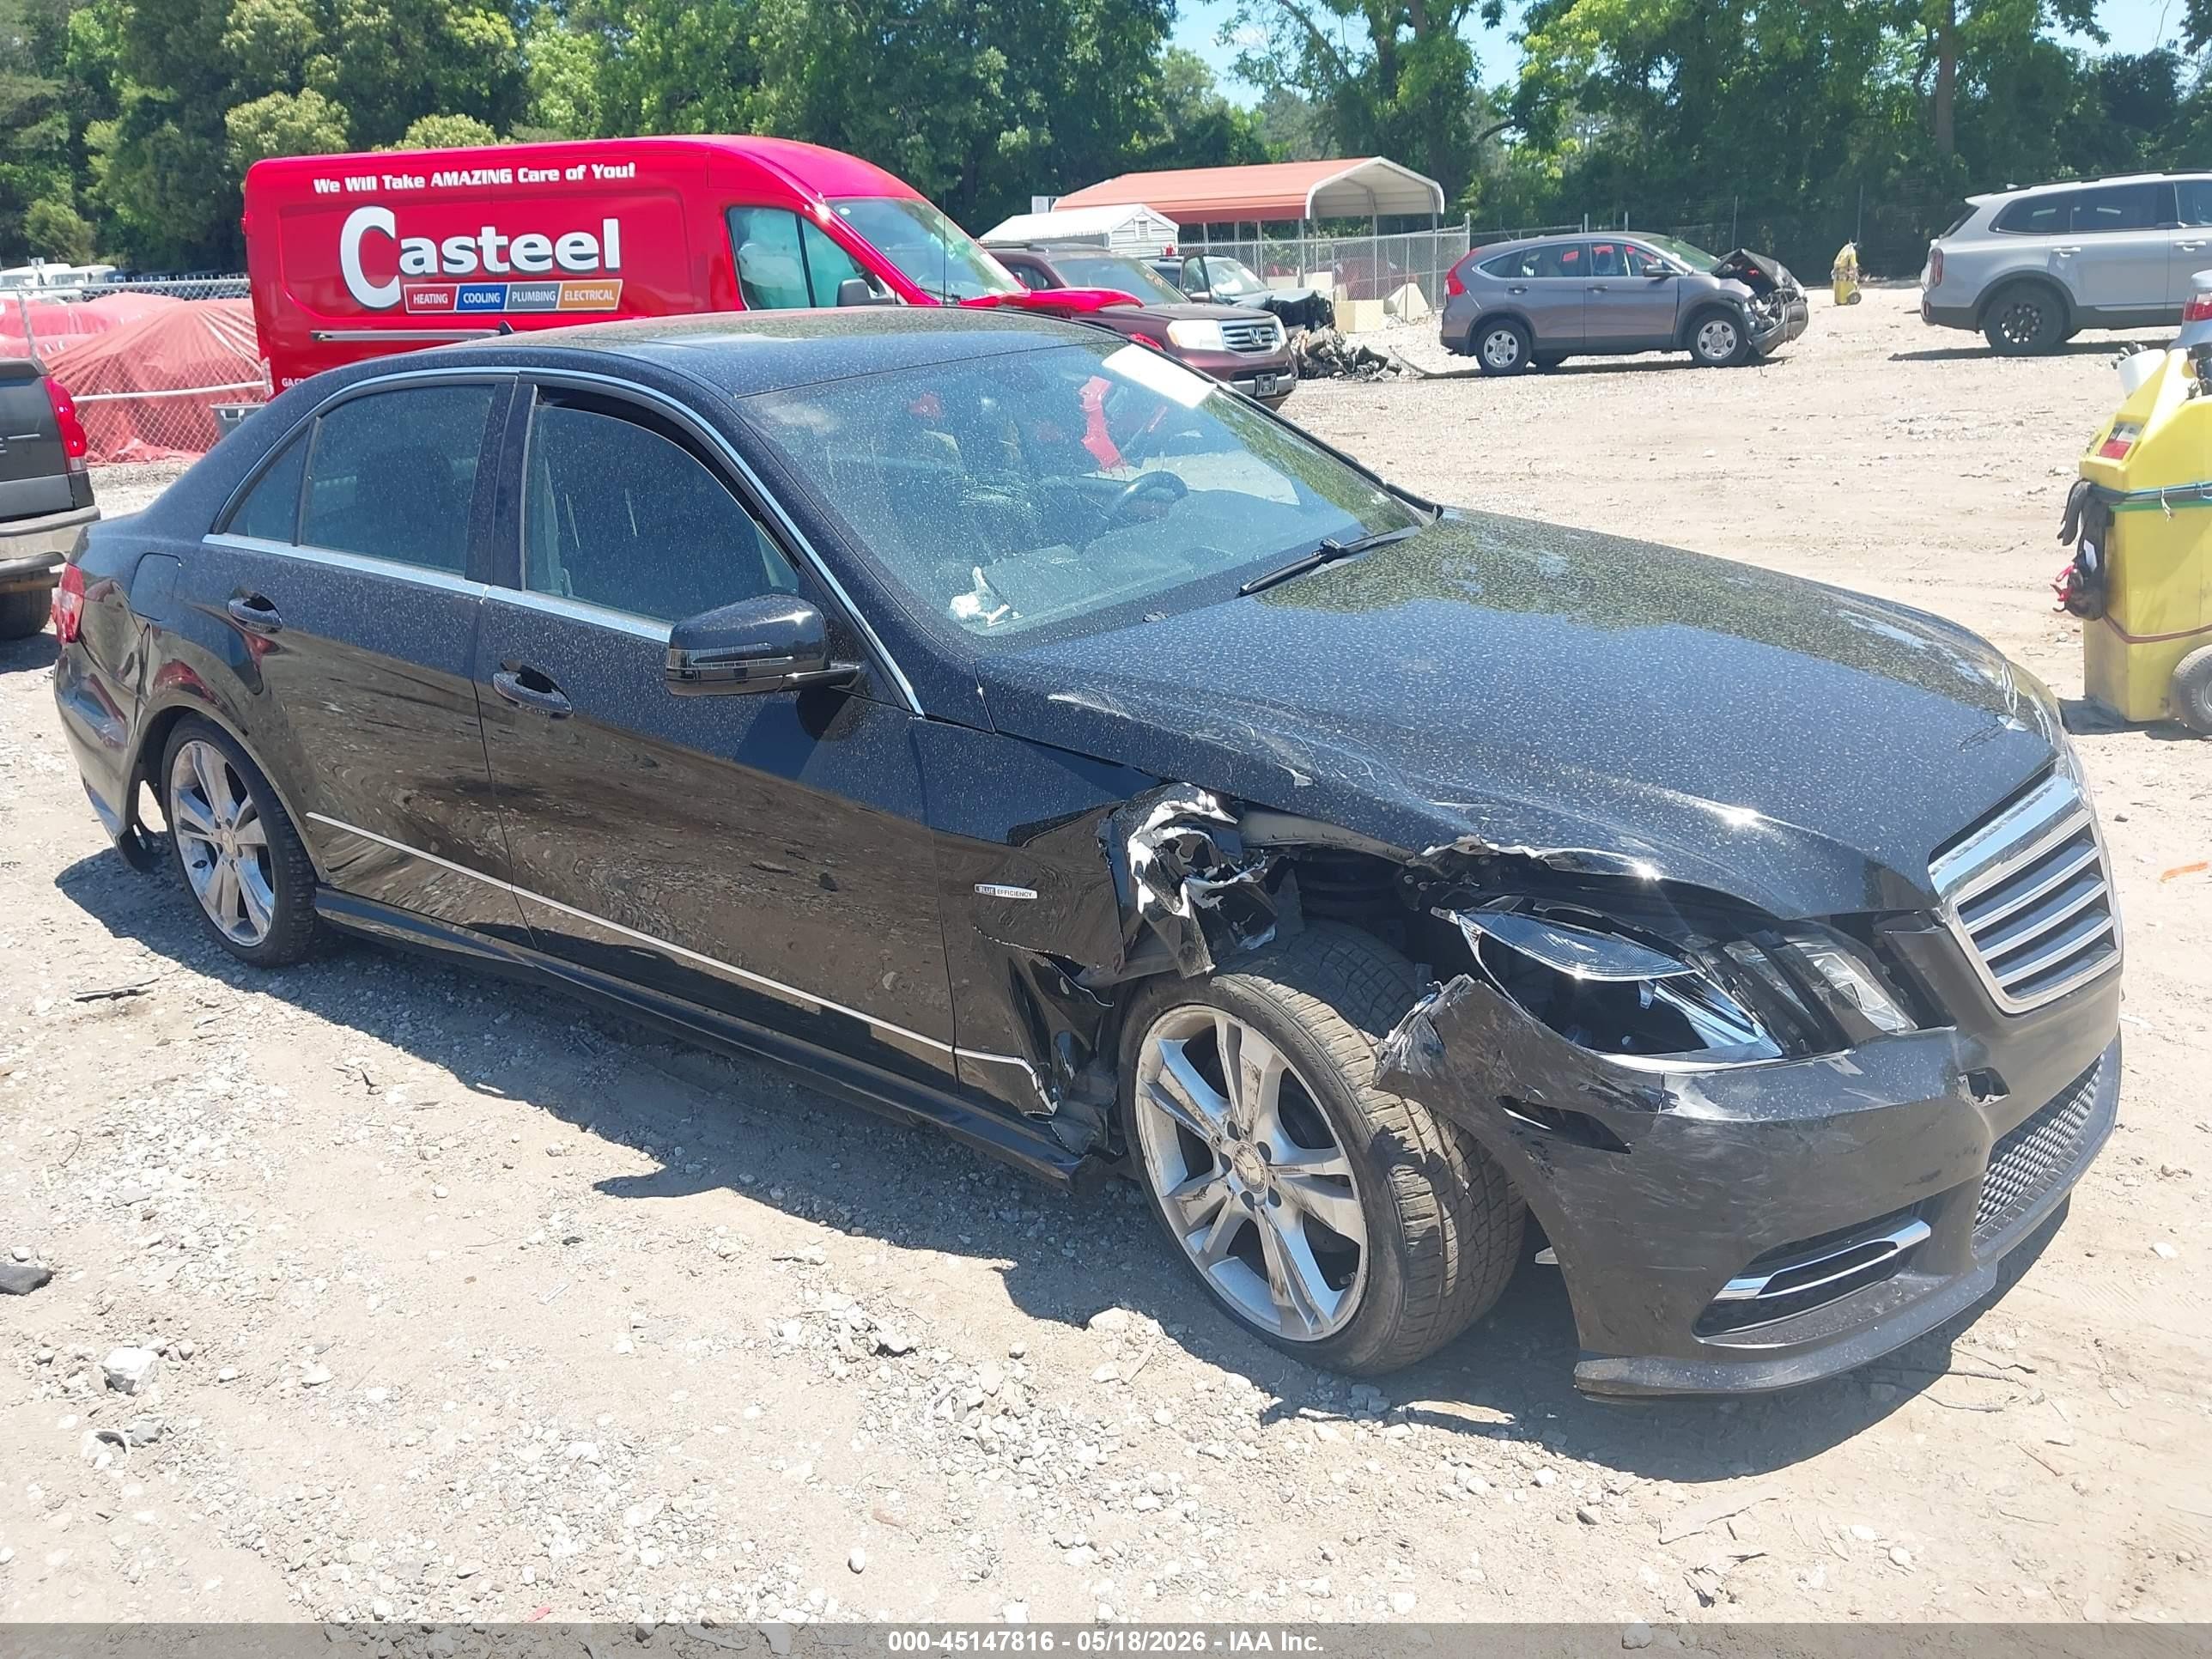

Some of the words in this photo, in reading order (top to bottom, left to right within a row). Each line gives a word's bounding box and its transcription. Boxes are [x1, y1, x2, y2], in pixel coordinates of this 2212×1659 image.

[313, 178, 340, 194] We
[345, 176, 378, 191] Will
[382, 174, 425, 191] Take
[431, 168, 513, 187] AMAZING
[518, 167, 560, 184] Care
[565, 164, 586, 181] of
[591, 162, 635, 179] You!
[340, 205, 621, 309] Casteel
[413, 293, 448, 305] HEATING
[463, 292, 501, 304] COOLING
[512, 290, 556, 302] PLUMBING
[563, 289, 615, 301] ELECTRICAL
